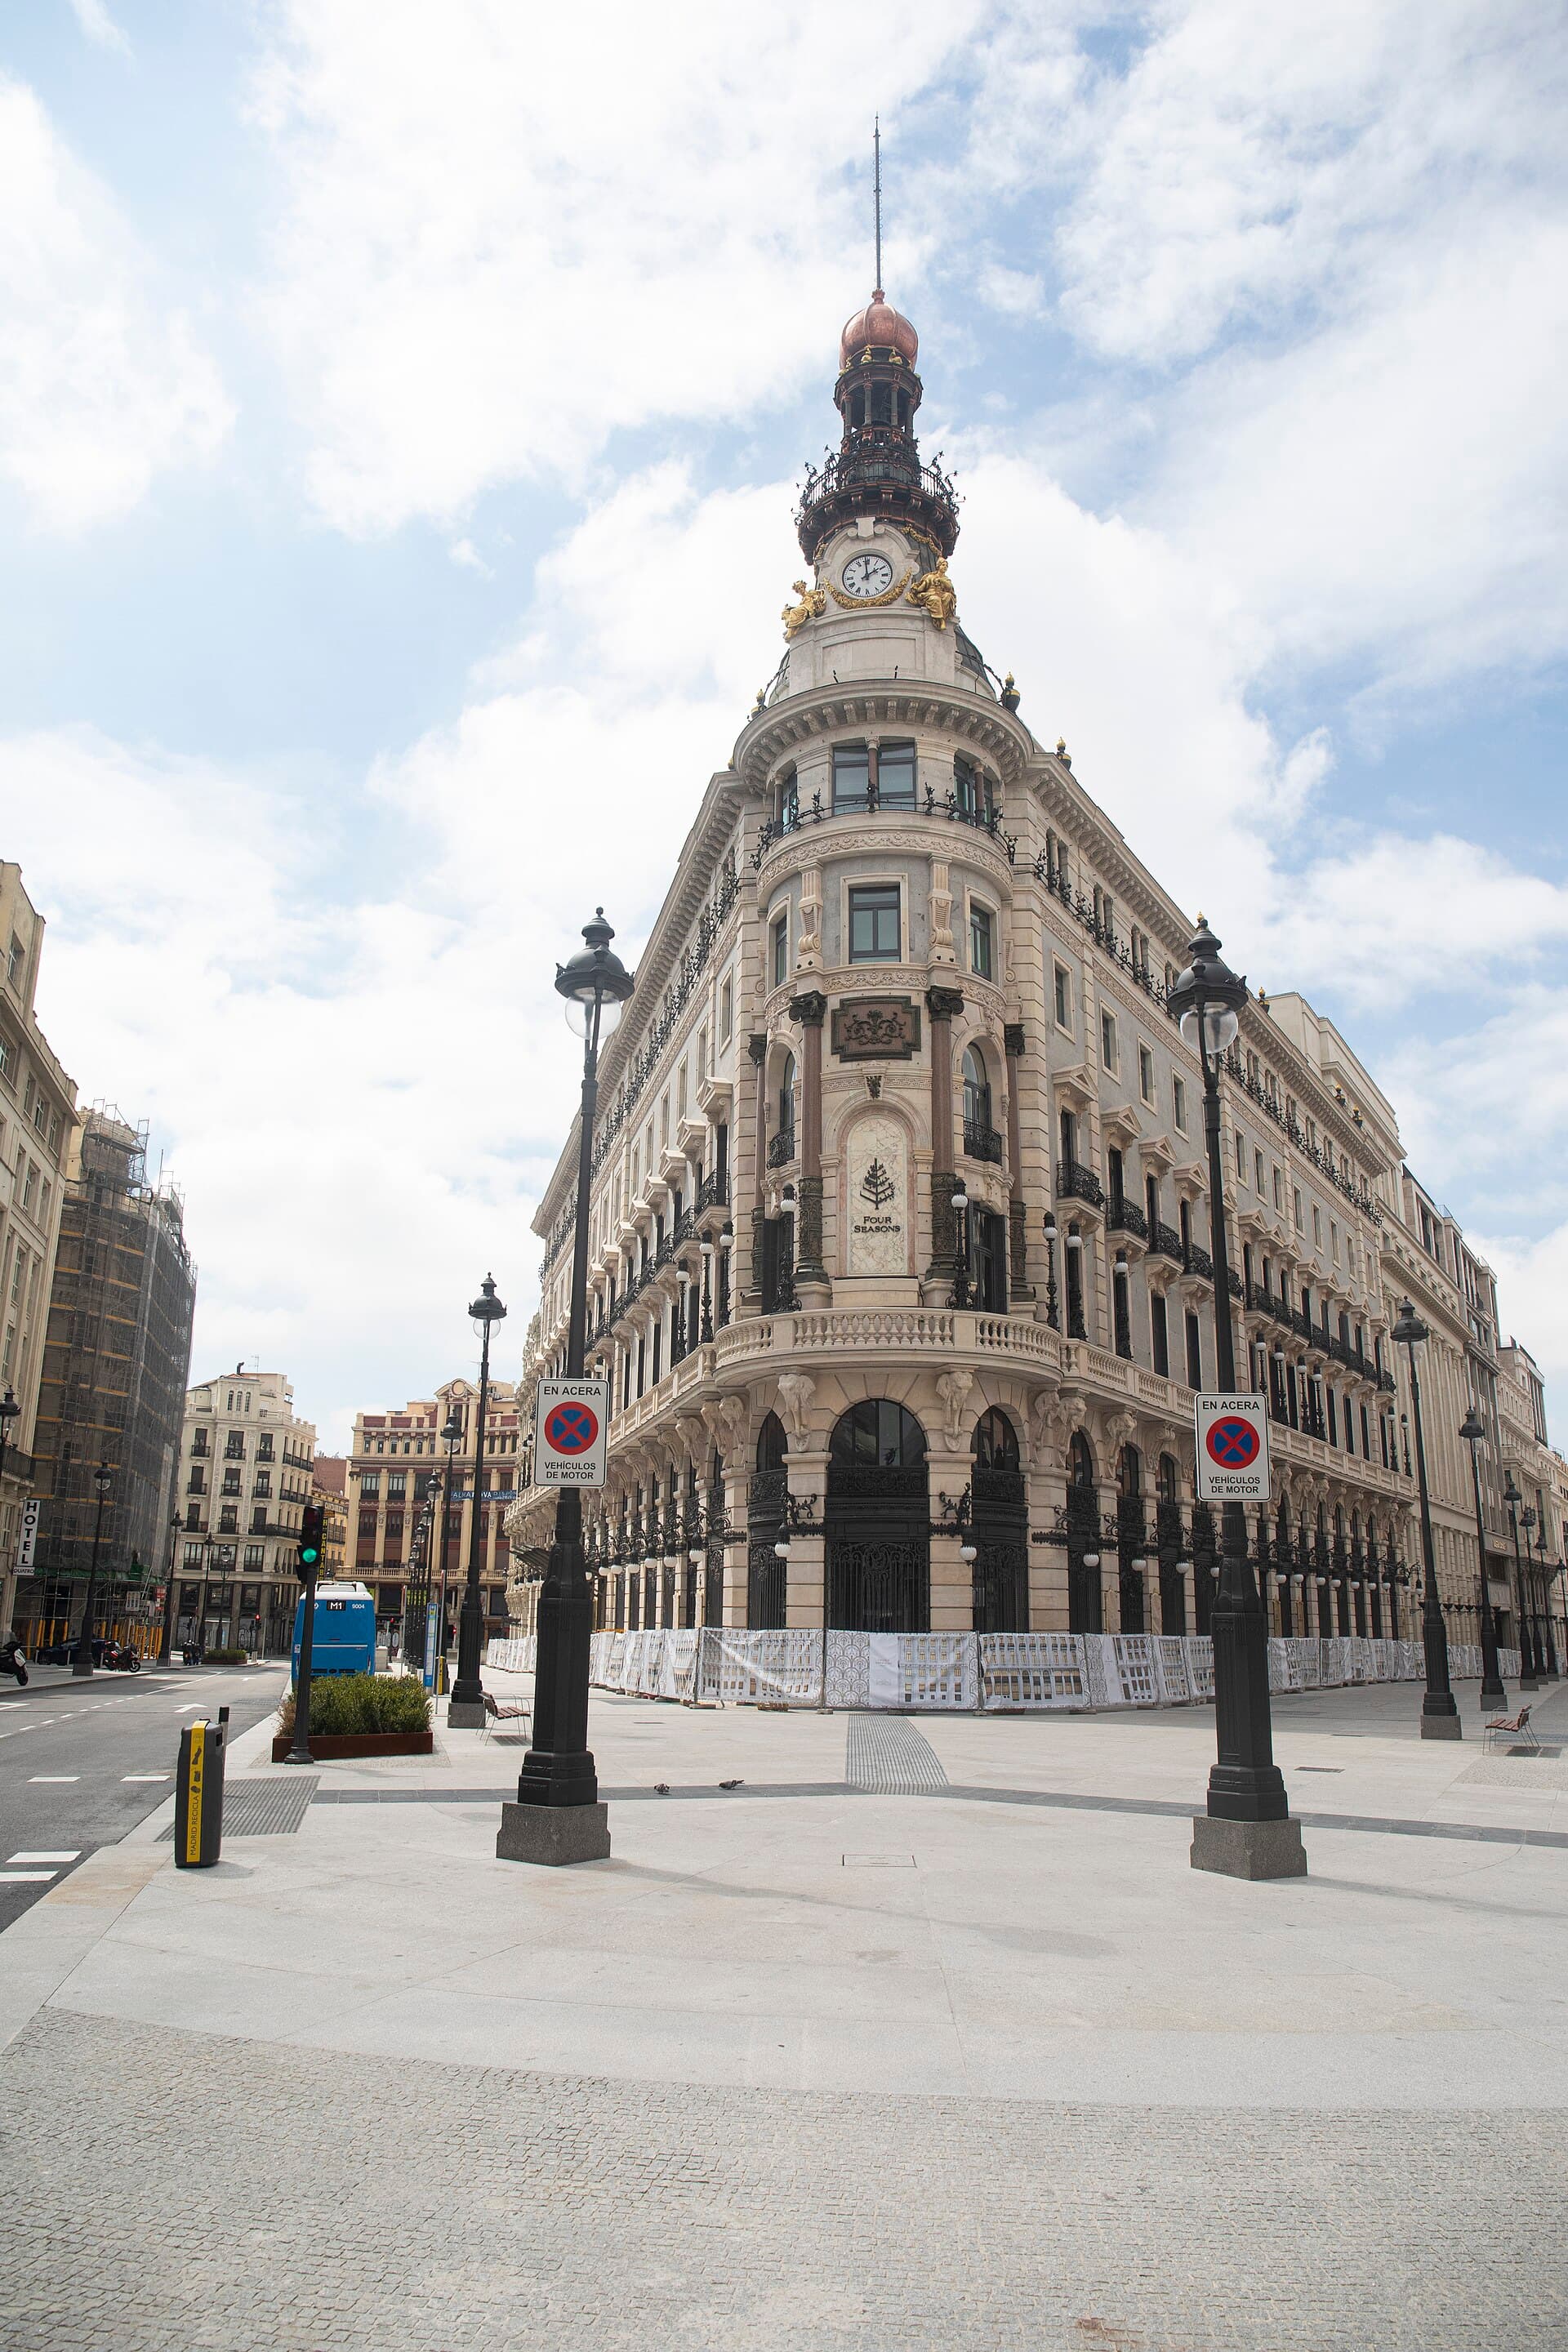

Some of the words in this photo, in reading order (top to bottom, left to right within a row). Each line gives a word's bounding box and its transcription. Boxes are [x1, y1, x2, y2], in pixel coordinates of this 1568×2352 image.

[863, 1216, 892, 1224] FOUR
[854, 1225, 901, 1233] SEASONS
[544, 1387, 559, 1395] EN
[562, 1387, 601, 1396] ACERA
[1202, 1401, 1218, 1410] EN
[1220, 1401, 1260, 1410] ACERA
[545, 1460, 596, 1470] VEHÍCULOS
[1209, 1475, 1260, 1484] VEHÍCULOS
[1211, 1486, 1223, 1494] DE
[1226, 1486, 1258, 1494] MOTOR
[21, 1502, 38, 1564] HOTEL
